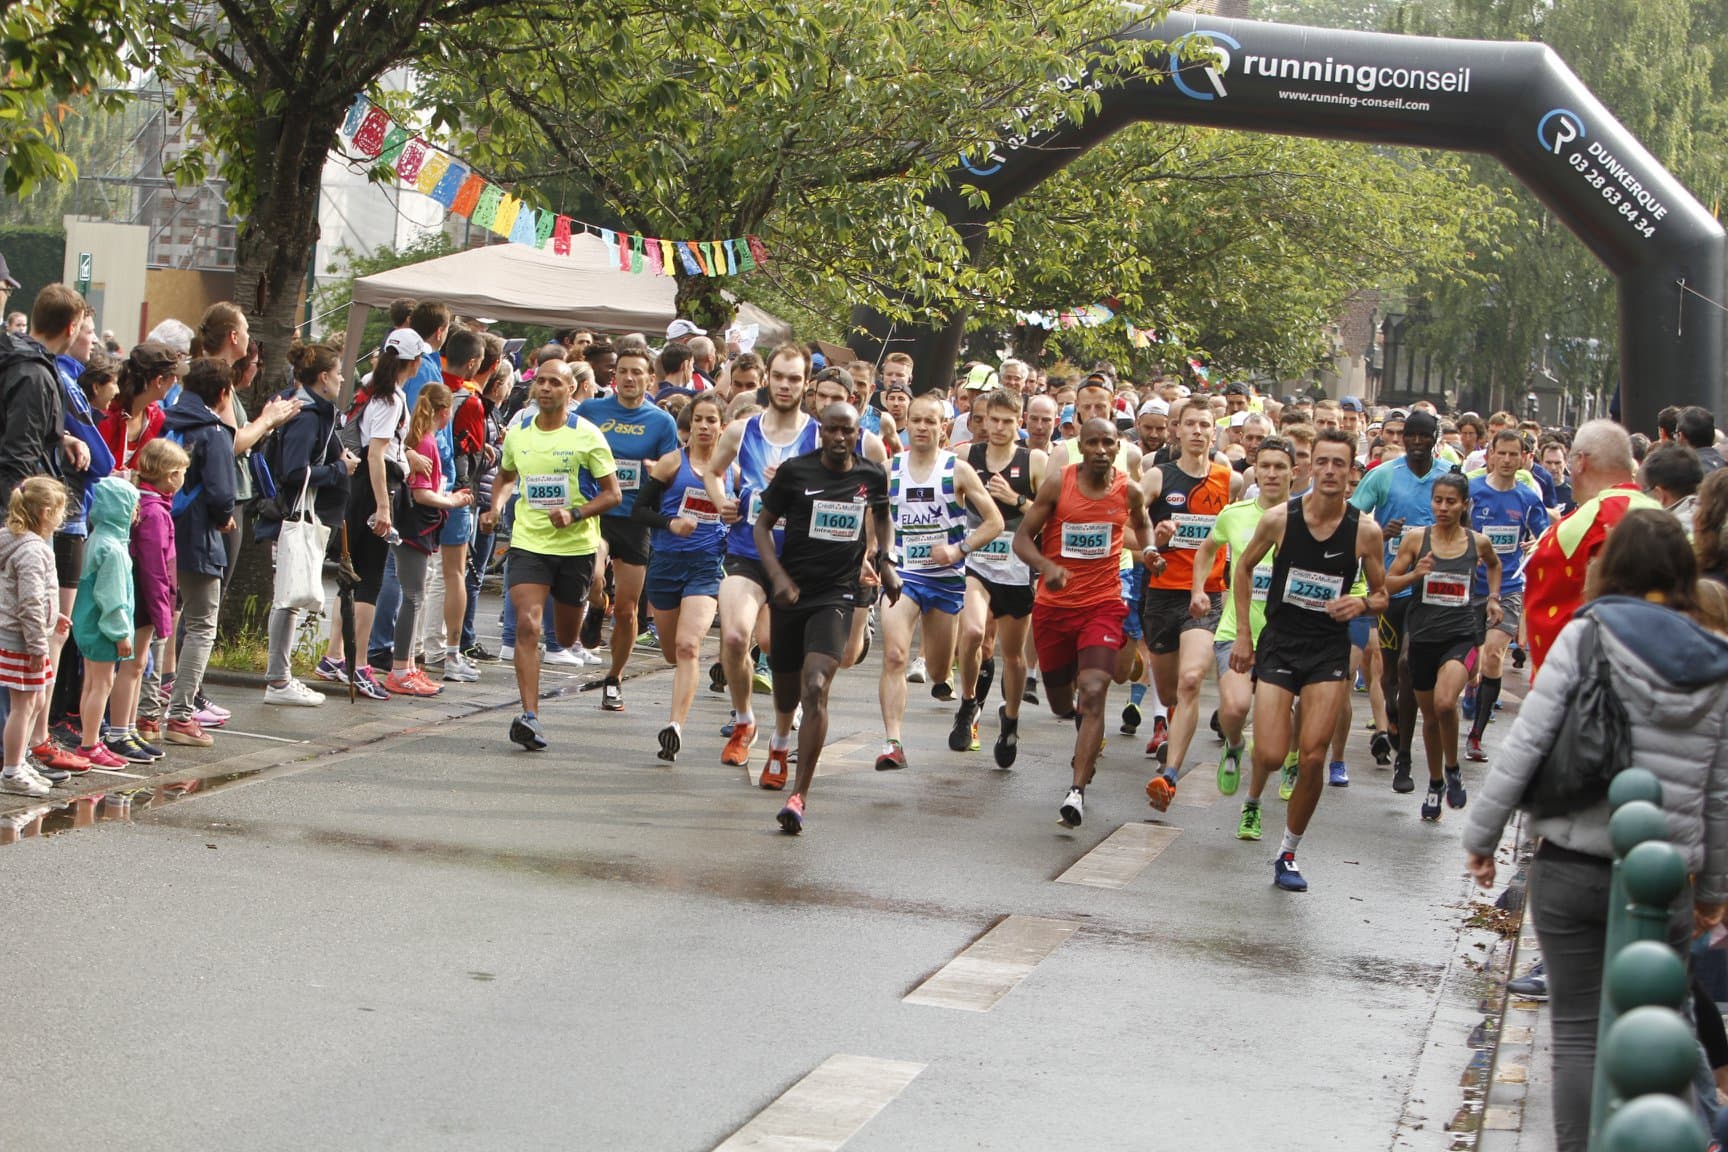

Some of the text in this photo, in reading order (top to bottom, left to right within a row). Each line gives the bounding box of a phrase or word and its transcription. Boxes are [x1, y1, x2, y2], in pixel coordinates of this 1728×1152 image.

[1243, 55, 1470, 93] runningconseil
[1278, 89, 1430, 111] www.running-conseil.com
[1587, 141, 1668, 221] DUNKERQUE
[1568, 152, 1655, 239] 03 28 63 84 34
[614, 423, 645, 435] asics
[616, 470, 633, 481] 62
[531, 486, 562, 499] 2859
[822, 514, 856, 529] 1602
[901, 513, 931, 525] ELAN
[1179, 525, 1212, 539] 2817
[1070, 534, 1103, 547] 2965
[1489, 535, 1513, 545] 2753
[977, 542, 1006, 553] 212
[1255, 576, 1272, 589] 27
[1294, 582, 1332, 599] 2758
